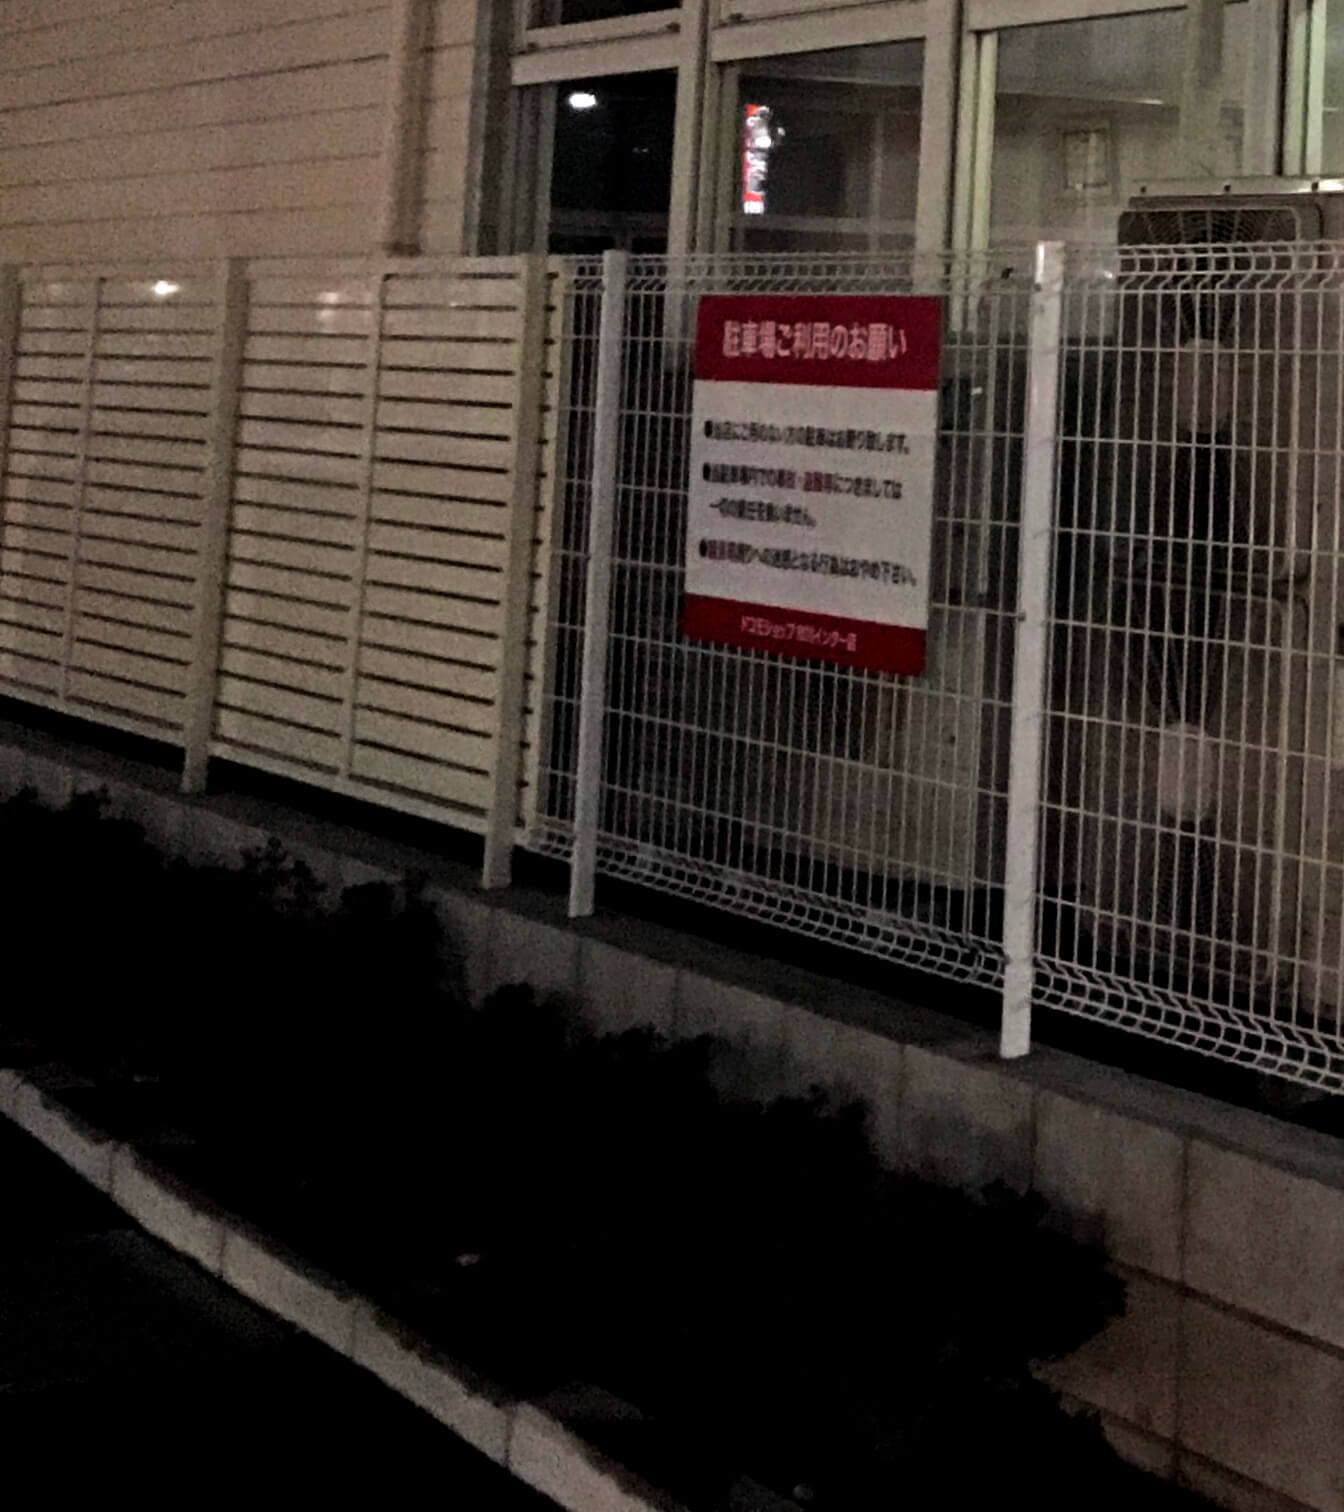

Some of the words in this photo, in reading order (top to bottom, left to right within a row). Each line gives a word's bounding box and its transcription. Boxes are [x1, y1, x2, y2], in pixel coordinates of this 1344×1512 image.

[722, 319, 908, 363] 駐車場ご利用のお願い
